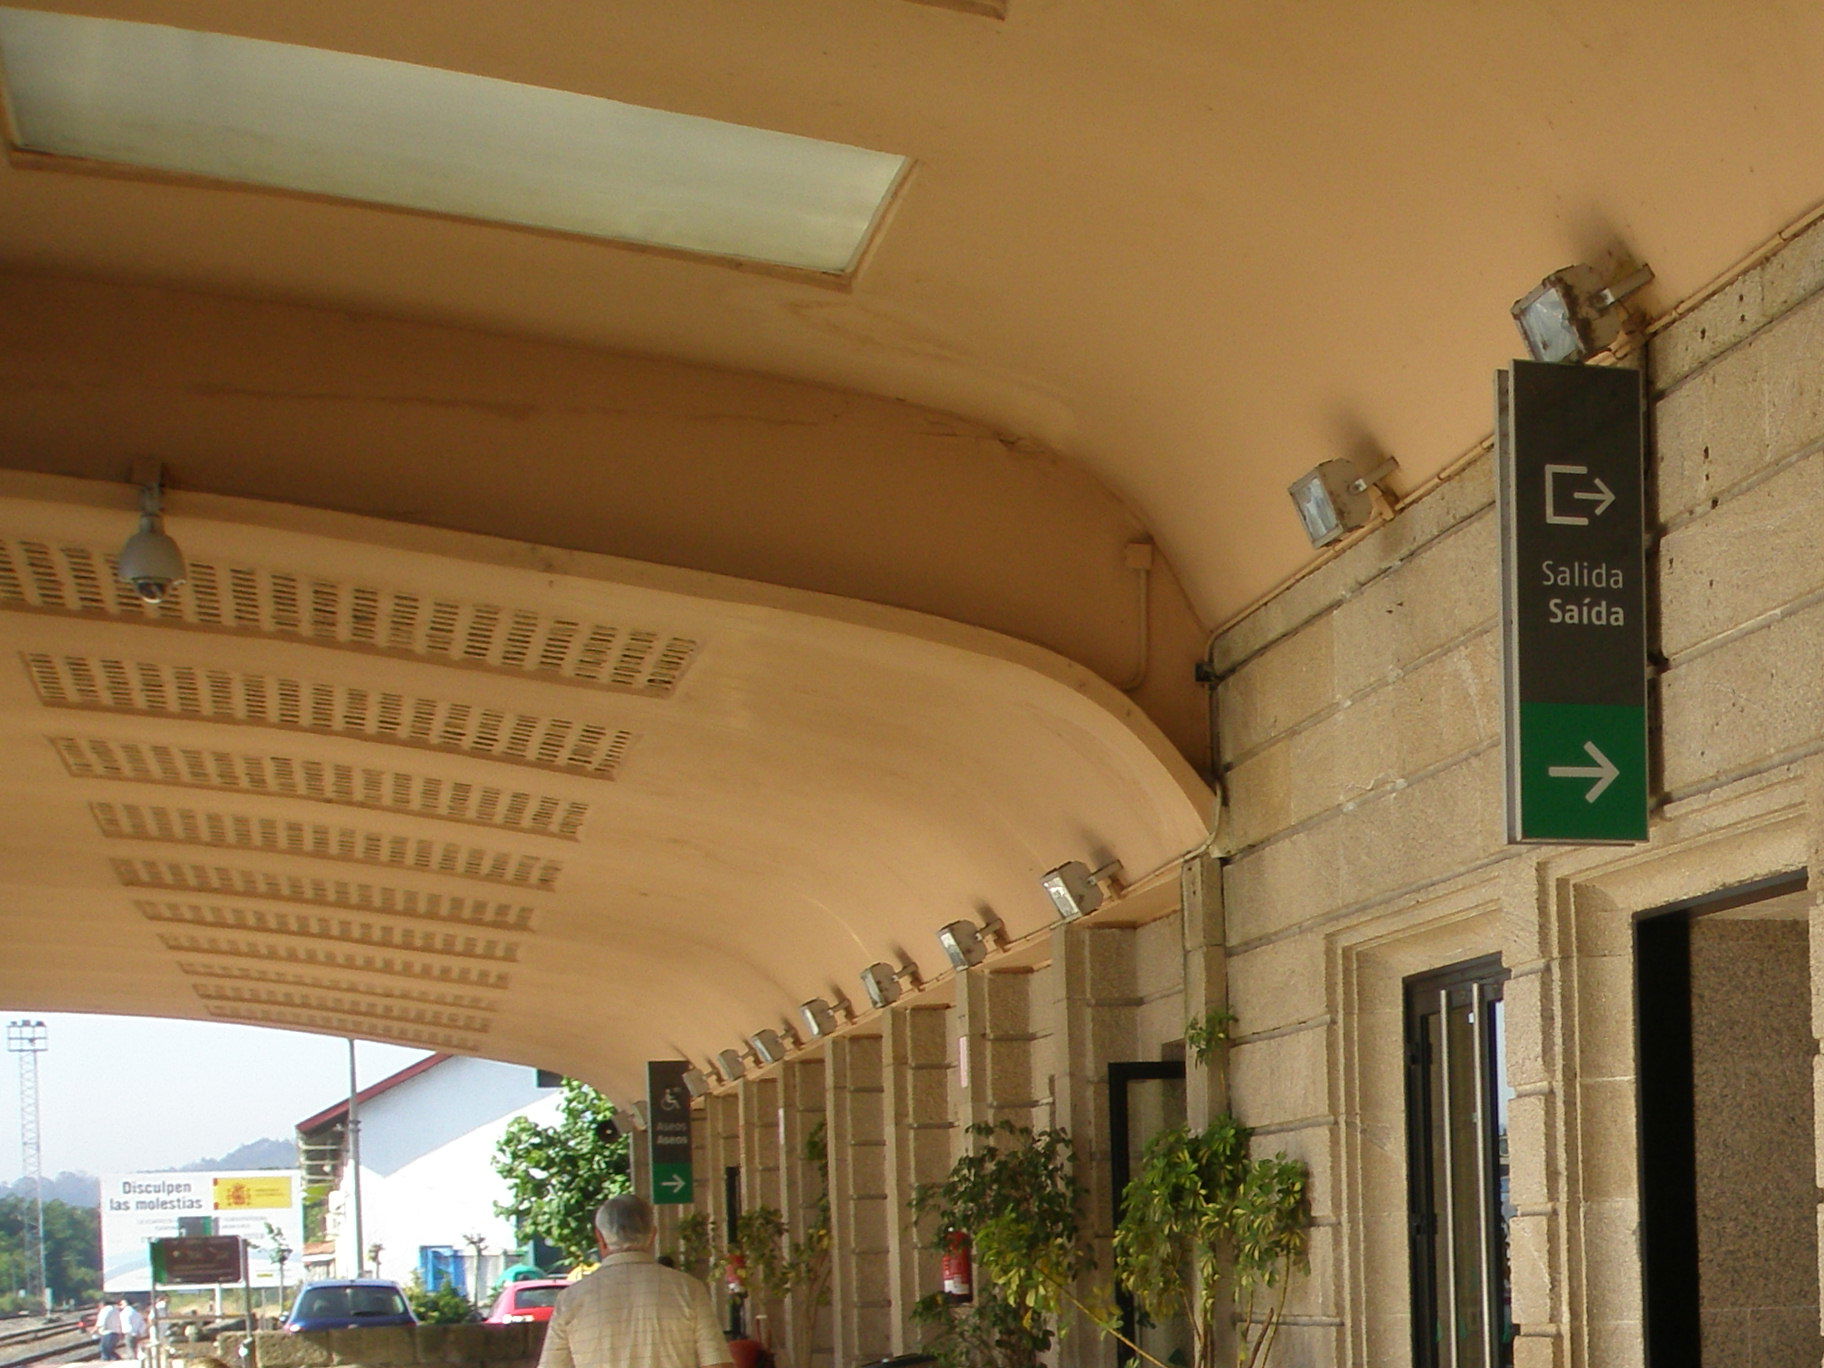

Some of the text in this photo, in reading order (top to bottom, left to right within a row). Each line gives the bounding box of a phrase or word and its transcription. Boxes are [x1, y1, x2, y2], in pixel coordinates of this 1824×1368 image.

[1541, 560, 1623, 589] Salida
[1548, 597, 1625, 627] Saída
[122, 1180, 192, 1196] Disculpen
[109, 1197, 203, 1211] las molestias
